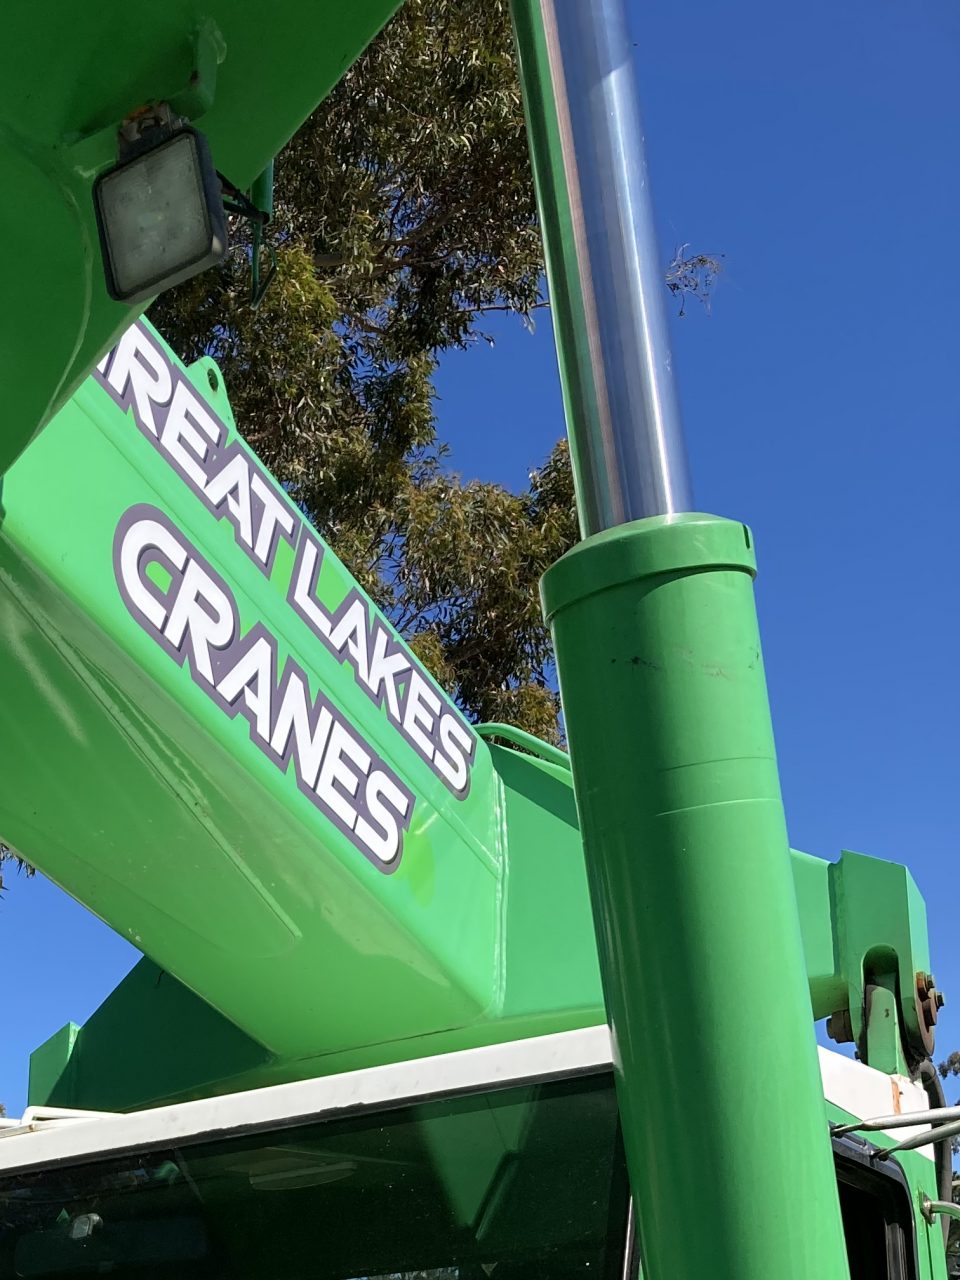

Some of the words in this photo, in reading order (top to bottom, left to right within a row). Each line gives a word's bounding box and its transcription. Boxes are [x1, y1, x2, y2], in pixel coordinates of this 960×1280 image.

[95, 321, 295, 570] REAT
[291, 537, 475, 791] LAKES
[120, 518, 411, 866] CRANES
